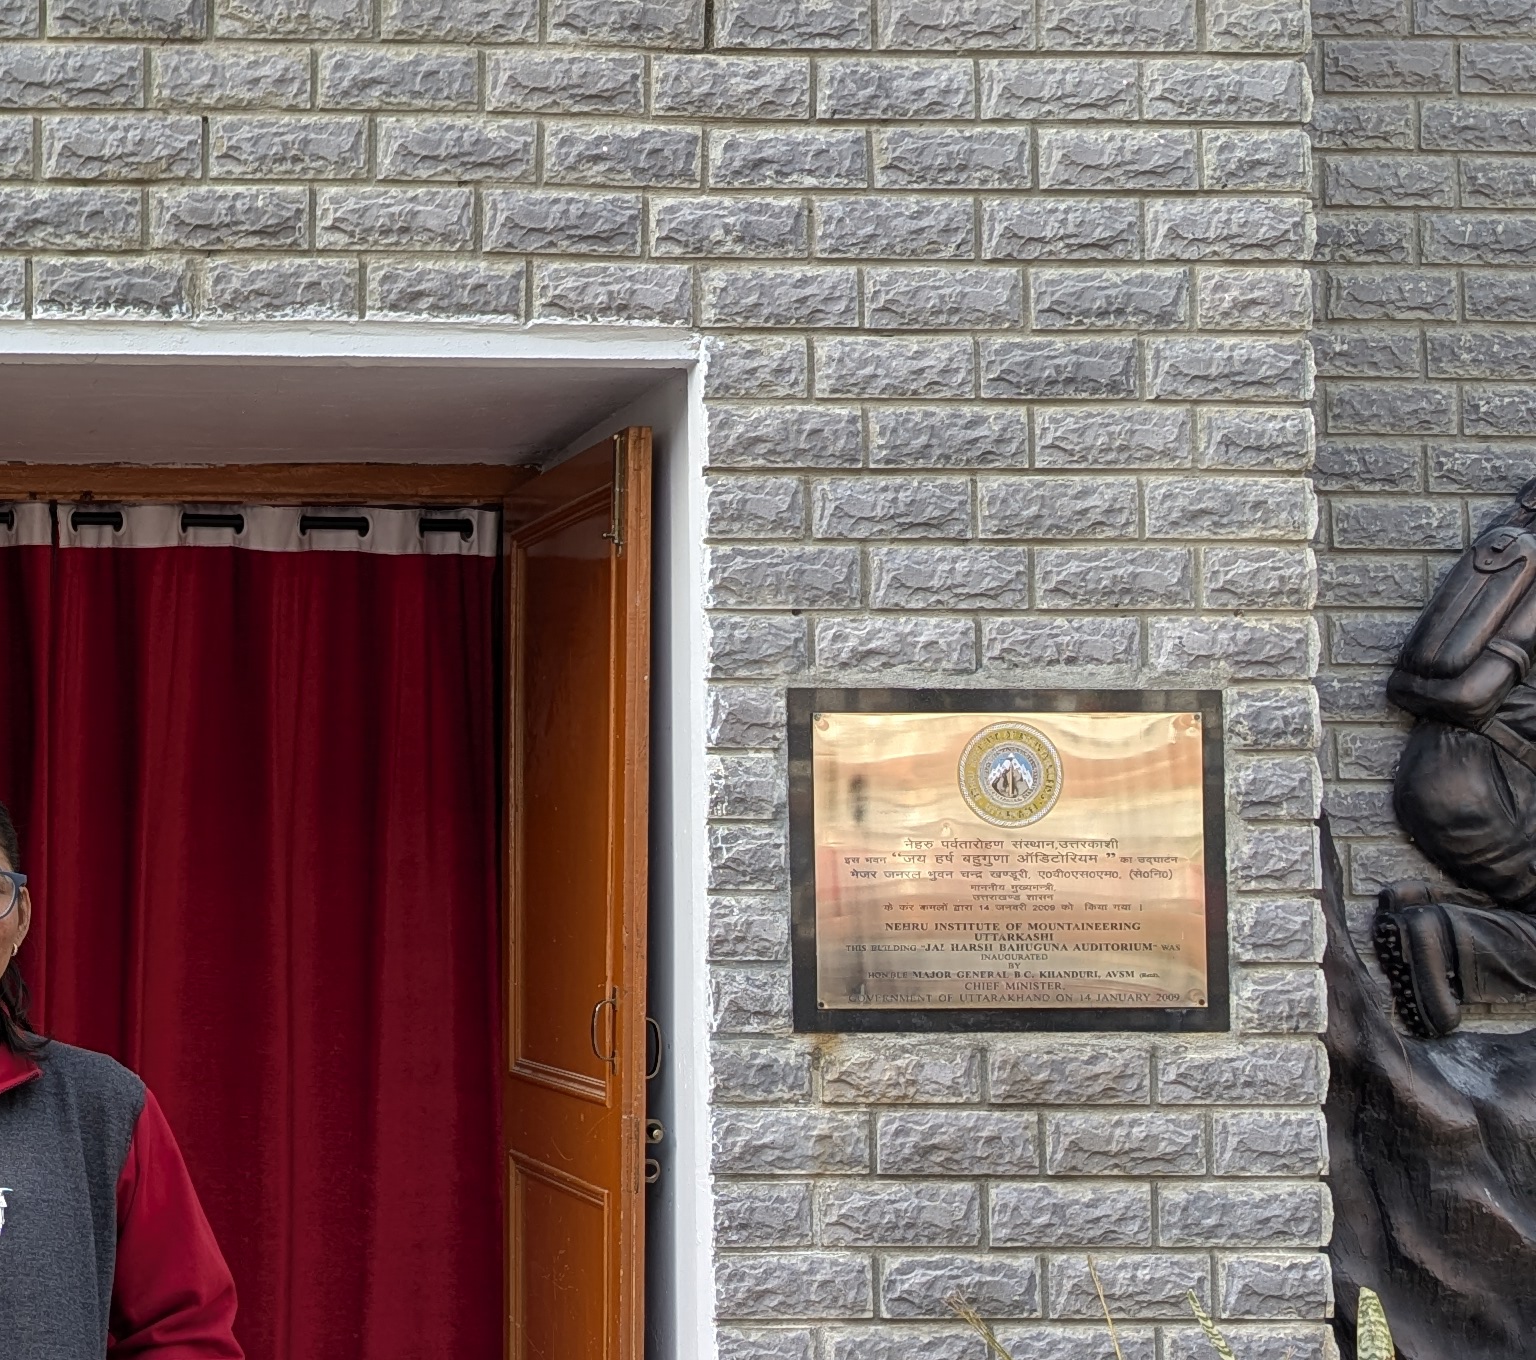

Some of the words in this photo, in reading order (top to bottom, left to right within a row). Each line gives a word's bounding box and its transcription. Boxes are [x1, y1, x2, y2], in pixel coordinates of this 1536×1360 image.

[904, 838, 934, 849] नेहरु
[942, 838, 1004, 849] पर्वतारोहण
[936, 852, 954, 863] हर्ष
[962, 855, 1009, 866] बहुगुणा
[1017, 852, 1098, 863] ऑडिटोरियम
[928, 871, 953, 881] भुवन
[885, 923, 928, 931] NEHRU
[935, 923, 1000, 931] INSTITUTE
[1006, 923, 1022, 931] OF
[1028, 923, 1141, 931] MOUNTAINEERING
[975, 933, 1053, 941] UTTARKASHI
[951, 944, 993, 952] HARSH
[999, 943, 1068, 951] BAHUGUNA
[964, 982, 999, 990] CHIEF
[848, 994, 932, 1003] GOVERNMENT
[938, 994, 953, 1002] OF
[960, 994, 1050, 1002] UTTARAKHAND
[1056, 994, 1073, 1002] ON
[1080, 994, 1091, 1002] 14
[1096, 994, 1151, 1002] JANUARY
[1157, 993, 1180, 1002] 2009
